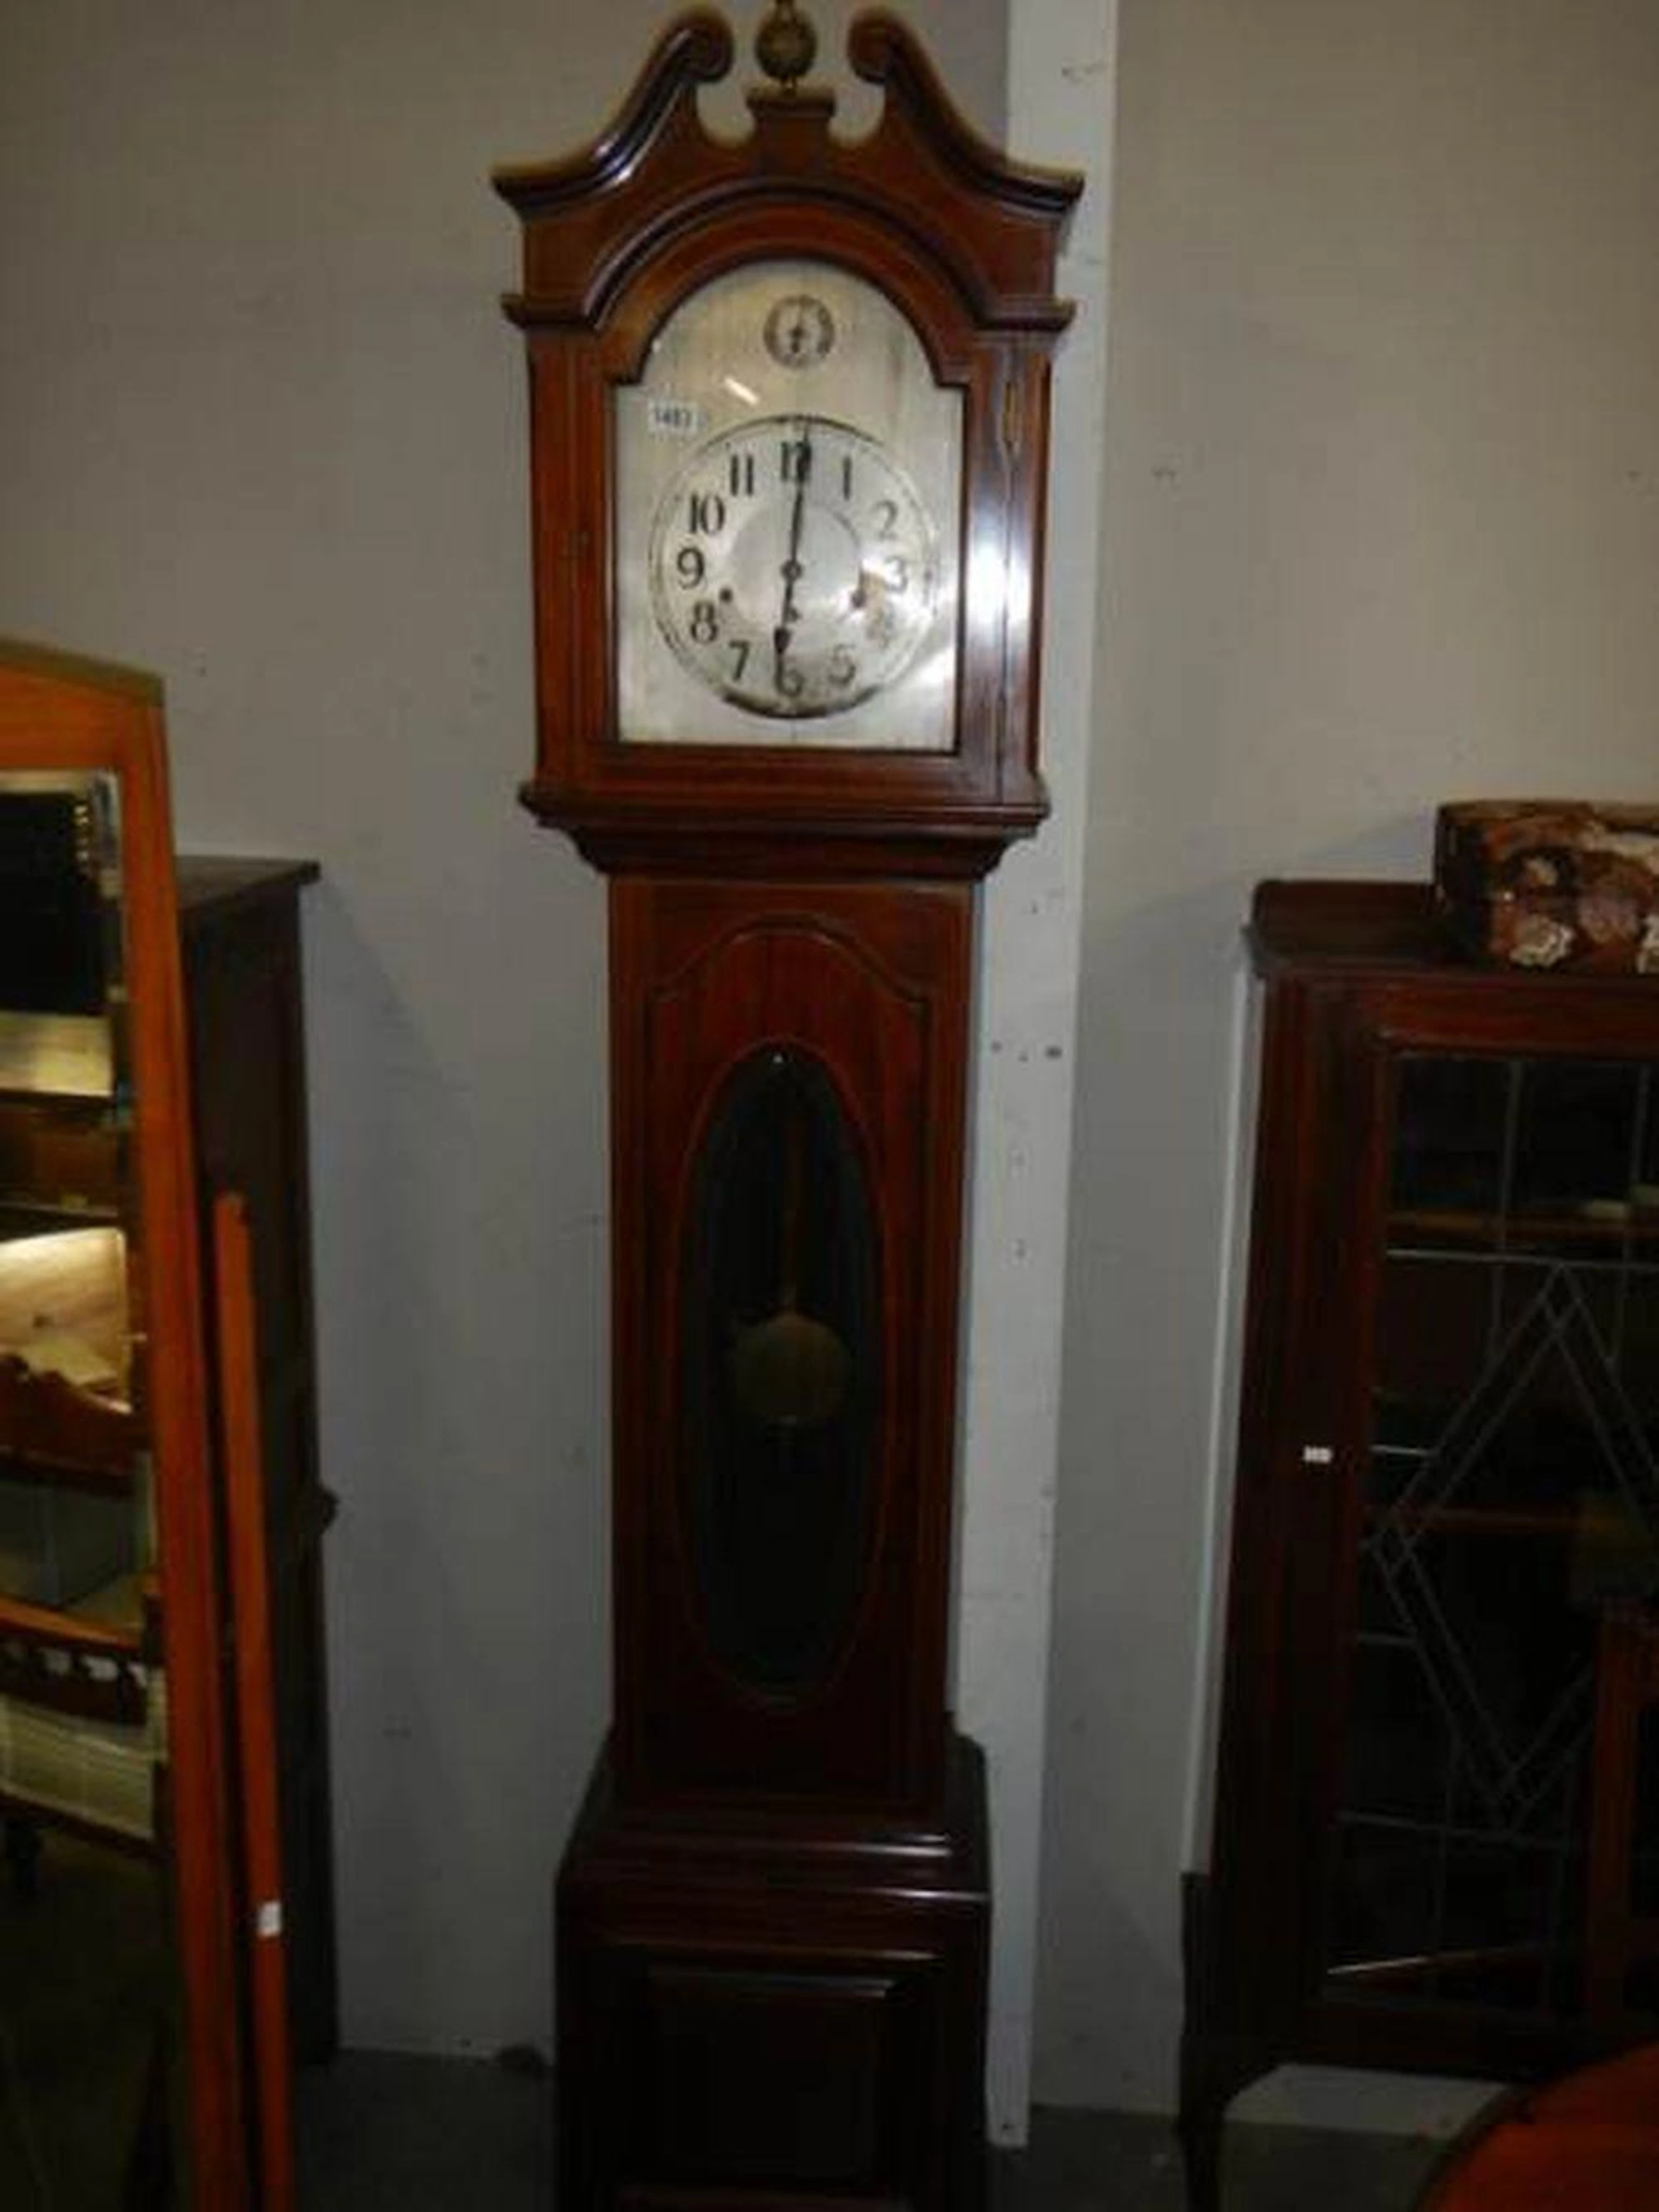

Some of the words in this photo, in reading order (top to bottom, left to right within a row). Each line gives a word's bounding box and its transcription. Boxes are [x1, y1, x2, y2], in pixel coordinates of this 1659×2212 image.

[730, 455, 753, 497] 11
[844, 456, 852, 501] 1
[690, 493, 725, 535] 10
[868, 499, 899, 541] 2
[677, 547, 704, 589] 9
[884, 556, 908, 592] 3
[691, 602, 718, 645] 8
[729, 640, 750, 681] 7
[828, 644, 856, 688] 5
